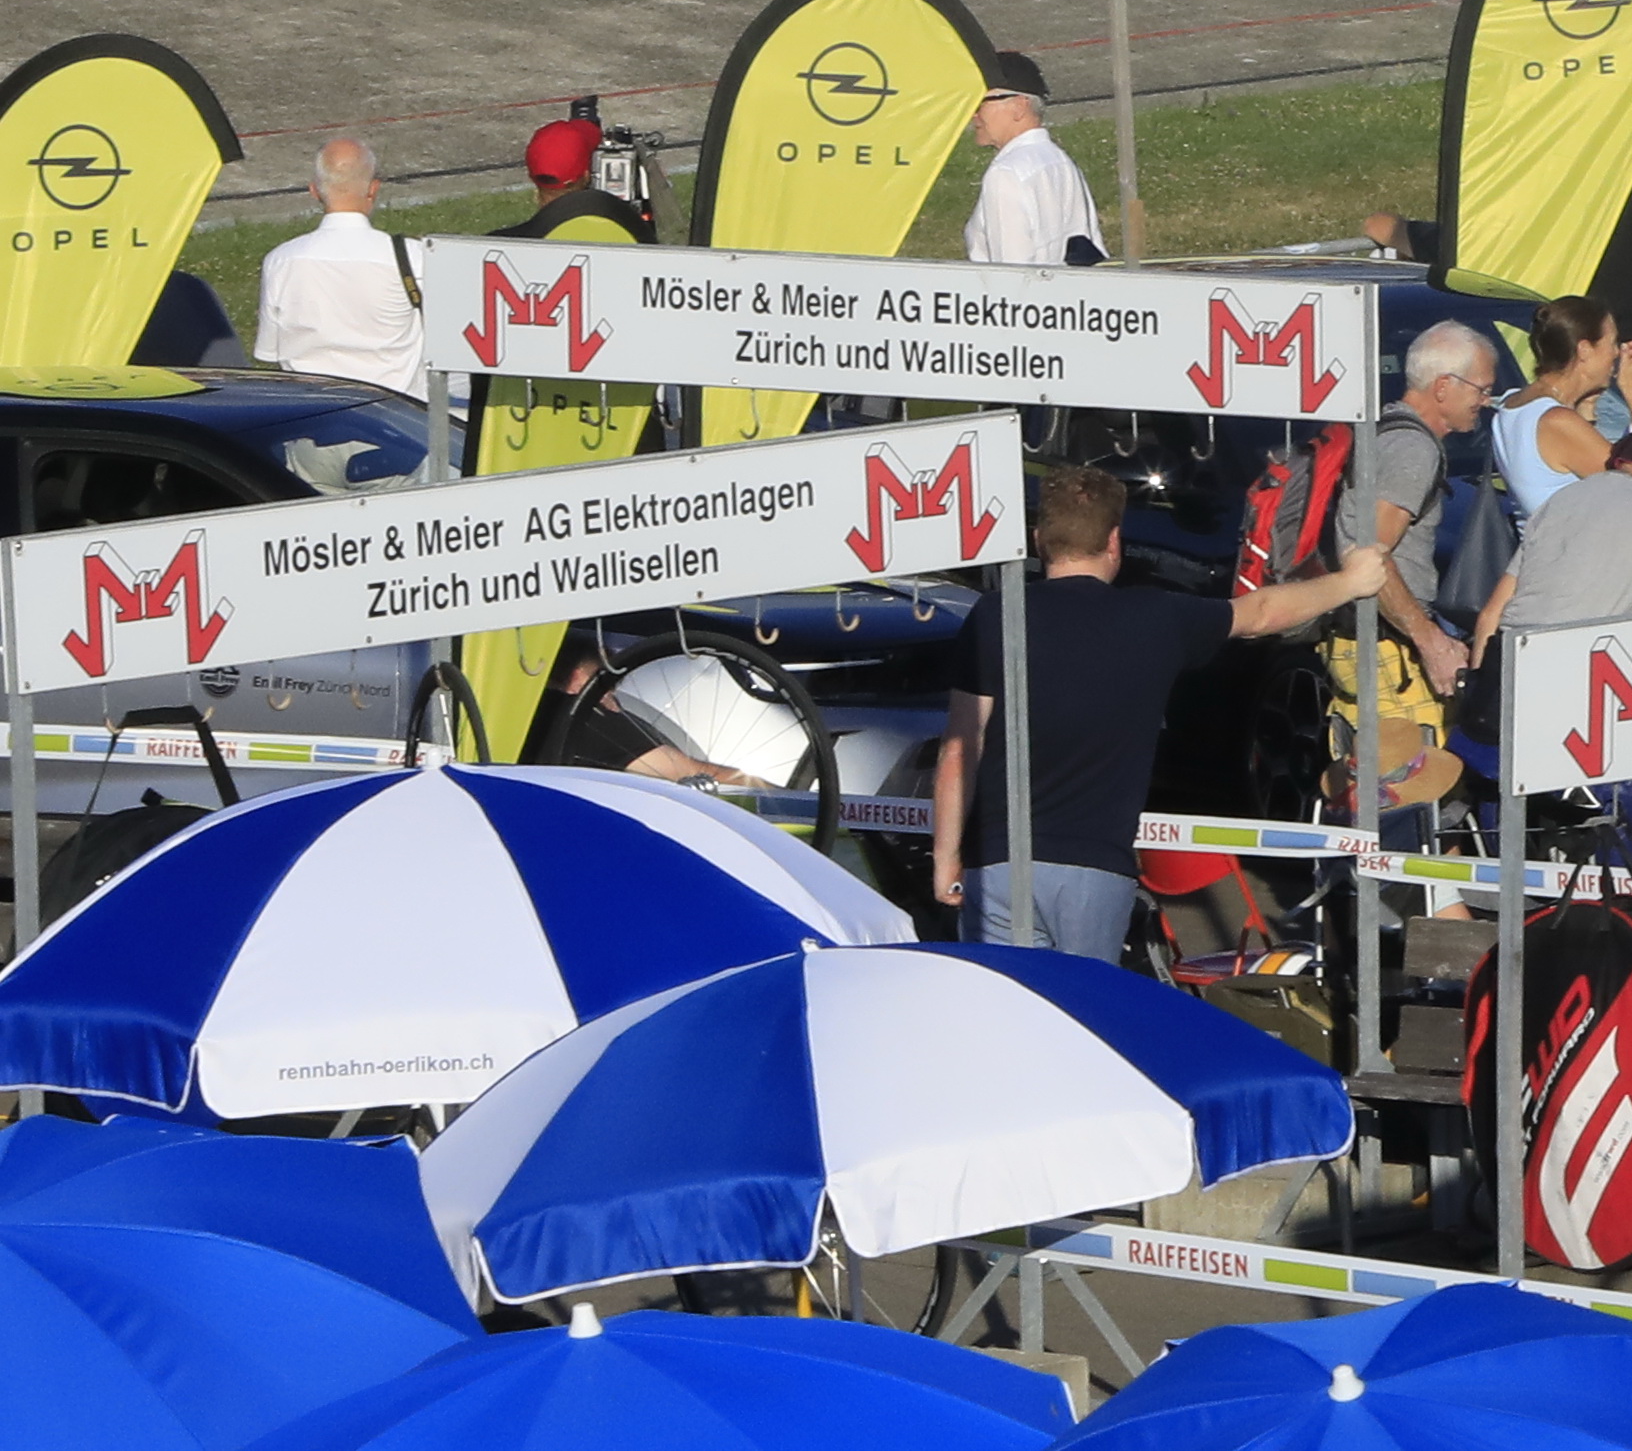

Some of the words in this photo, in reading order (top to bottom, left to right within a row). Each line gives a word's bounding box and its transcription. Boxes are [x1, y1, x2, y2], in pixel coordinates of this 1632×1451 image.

[777, 140, 911, 168] OPEL
[11, 227, 148, 252] OPEL
[641, 276, 744, 314] Mösler
[754, 283, 772, 314] &
[781, 283, 859, 320] Meier
[876, 287, 923, 323] AG
[933, 291, 1159, 342] Elektroanlagen
[734, 329, 826, 366] Zürich
[835, 334, 889, 372] und
[900, 340, 1064, 381] Wallisellen
[262, 525, 372, 577] Mösler
[382, 531, 405, 559] &
[416, 517, 503, 557] Meier
[524, 508, 572, 545] AG
[584, 477, 815, 534] Elektroanlagen
[367, 572, 471, 618] Zürich
[482, 568, 540, 604] und
[550, 541, 719, 596] Wallisellen
[284, 677, 314, 694] Frey
[838, 795, 929, 828] RAIFFEISEN
[277, 1051, 496, 1082] rennbahn-oerlikon.ch
[1128, 1239, 1249, 1279] RAIFFEISEN
